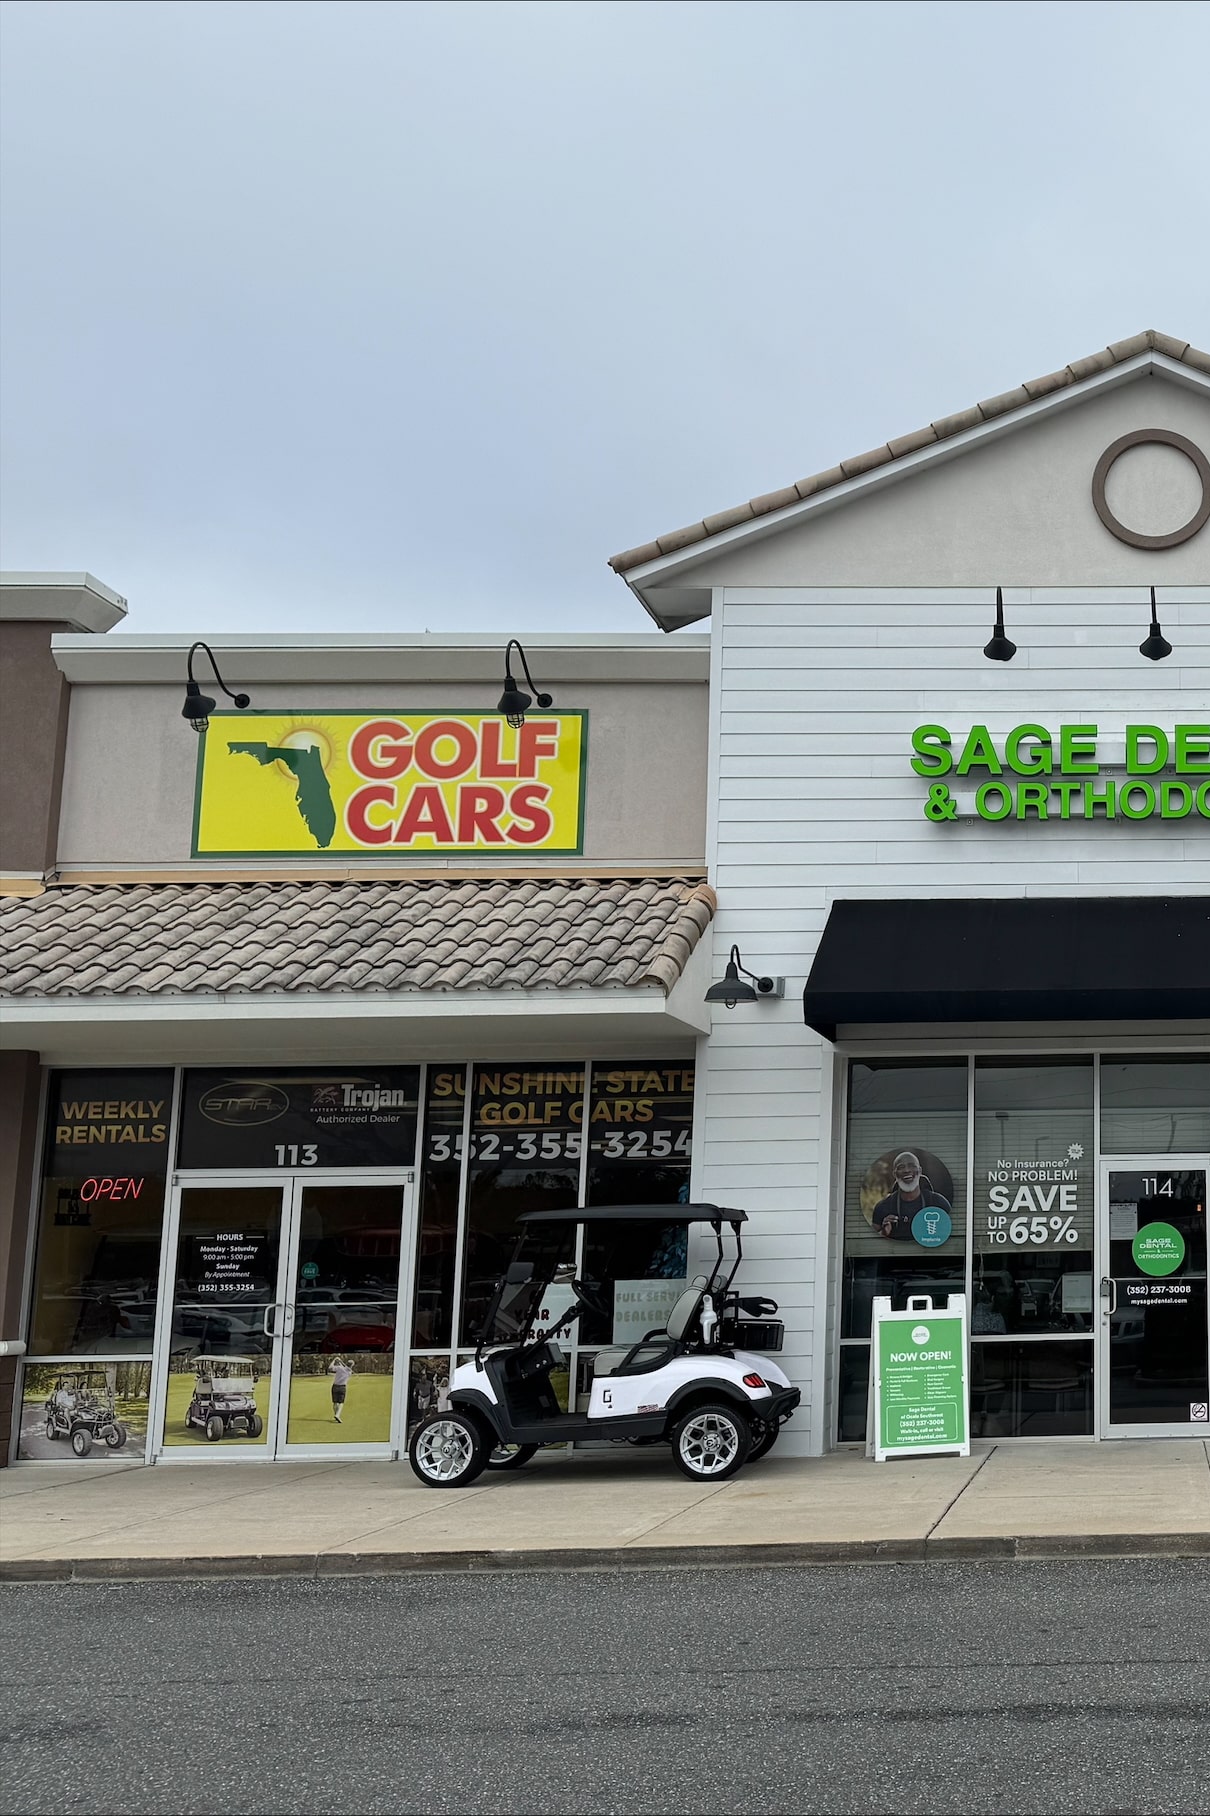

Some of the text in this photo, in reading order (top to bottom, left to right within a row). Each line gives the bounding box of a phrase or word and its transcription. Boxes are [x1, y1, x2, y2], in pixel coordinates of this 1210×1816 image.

[349, 720, 559, 780] GOLF
[910, 723, 1099, 776] SAGE
[924, 782, 957, 823] &
[346, 785, 552, 844] CARS
[605, 1070, 695, 1093] STATE
[341, 1084, 404, 1112] Trojan
[61, 1100, 165, 1120] WEEKLY
[316, 1114, 400, 1124] Authorized Dealer
[480, 1099, 654, 1125] GOLF CARS
[56, 1124, 167, 1144] RENTALS
[274, 1144, 318, 1166] 113
[429, 1130, 693, 1161] 352-355-3254
[997, 1159, 1069, 1168] No Insurance?
[988, 1169, 1078, 1182] NO PROBLEM!
[80, 1178, 144, 1201] OPEN
[1142, 1178, 1173, 1197] 114
[988, 1184, 1078, 1213] SAVE
[988, 1216, 1007, 1229] UP
[1009, 1216, 1079, 1244] 65%
[216, 1233, 244, 1241] HOURS
[987, 1231, 1007, 1244] TO
[200, 1245, 226, 1253] Monday
[230, 1245, 259, 1253] Saturday
[215, 1262, 240, 1270] Sunday
[198, 1283, 255, 1292] (352) 355-3254
[616, 1292, 642, 1303] FULL
[1126, 1284, 1191, 1295] (352) 237-3008
[890, 1351, 952, 1362] NOW OPEN!
